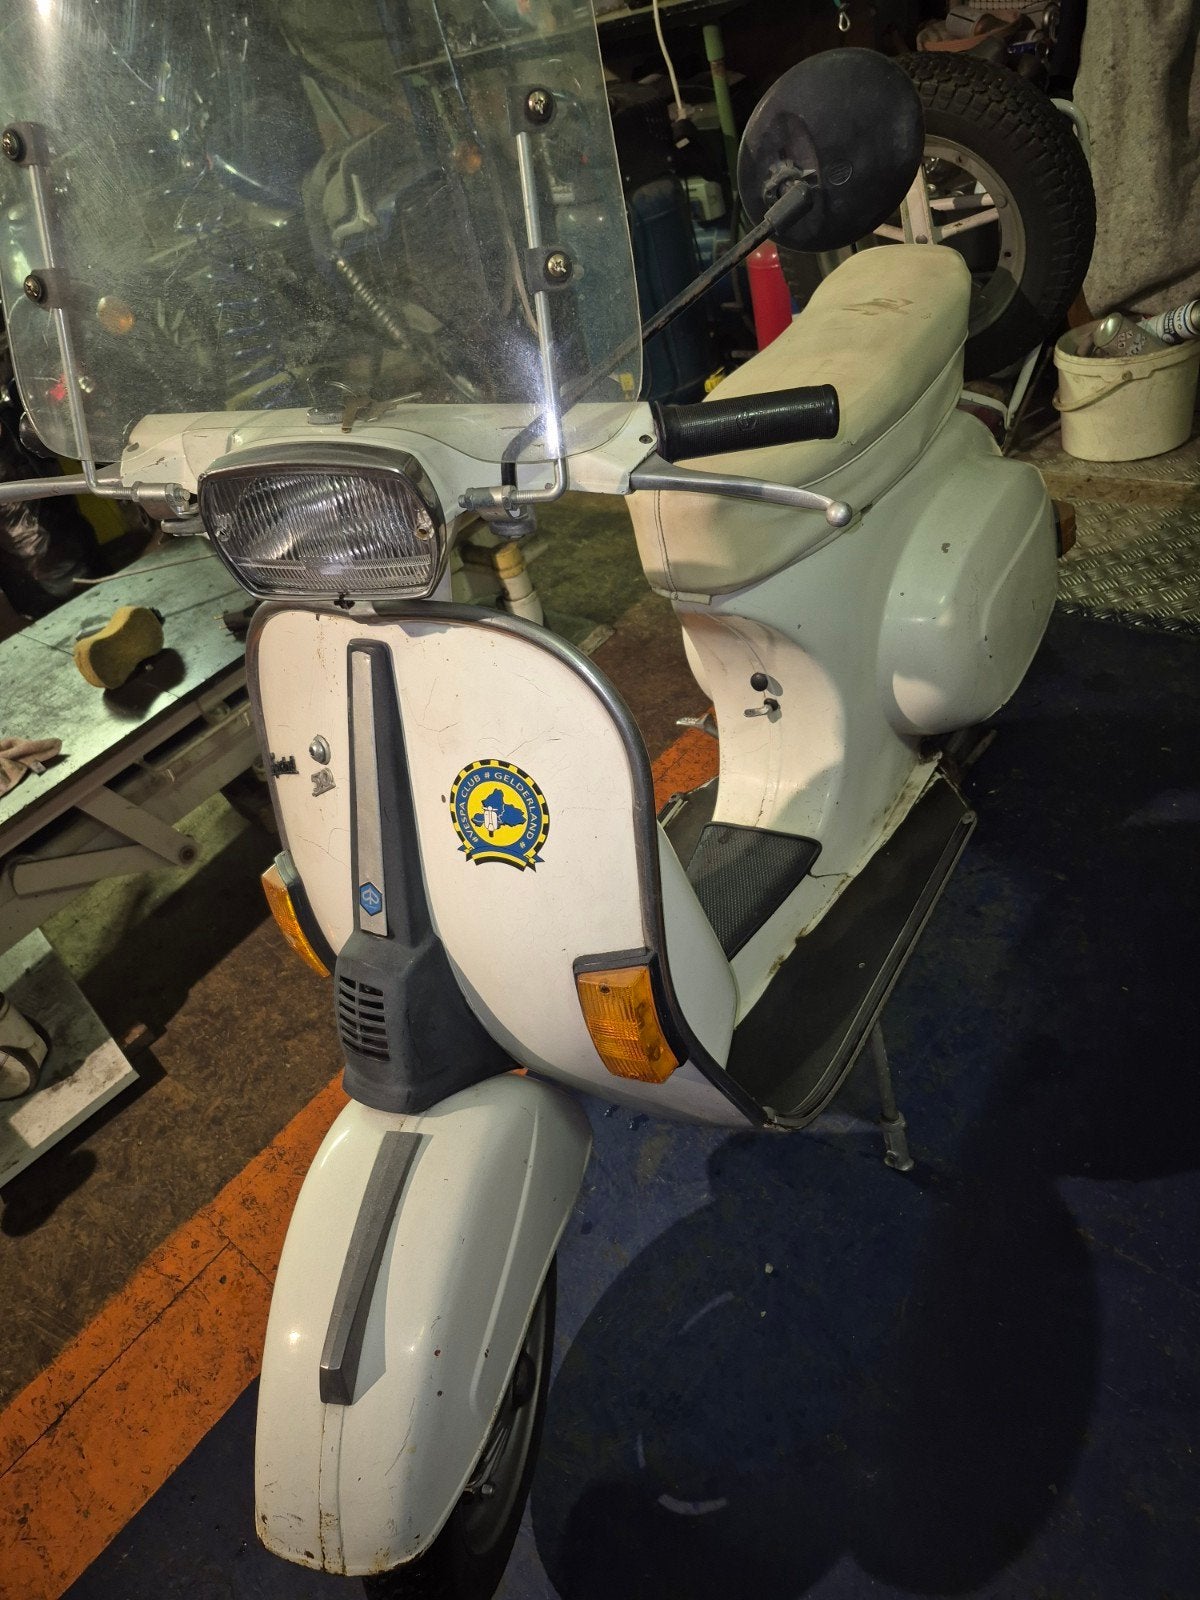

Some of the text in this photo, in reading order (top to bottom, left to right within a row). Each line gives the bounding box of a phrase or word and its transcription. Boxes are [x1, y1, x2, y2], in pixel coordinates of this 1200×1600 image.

[461, 774, 481, 798] CLUB
[459, 801, 474, 838] VESPA
[494, 772, 538, 840] GELDERLAND
